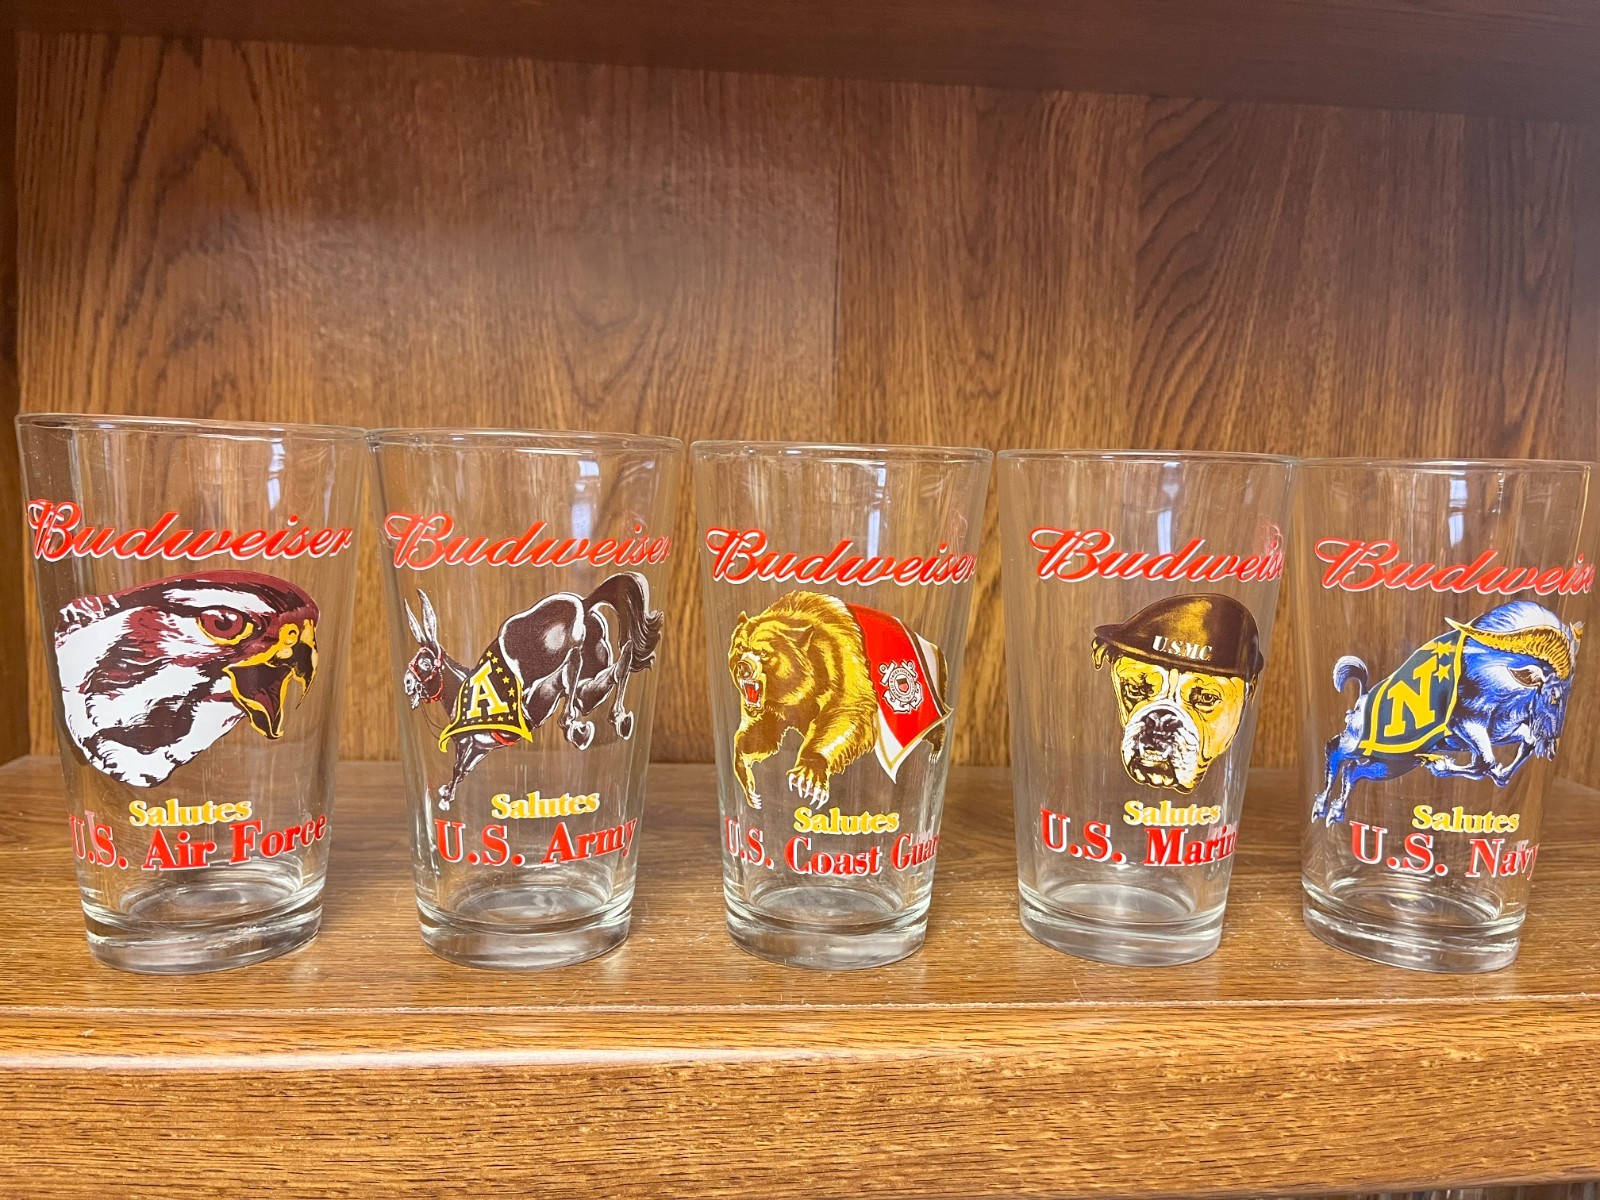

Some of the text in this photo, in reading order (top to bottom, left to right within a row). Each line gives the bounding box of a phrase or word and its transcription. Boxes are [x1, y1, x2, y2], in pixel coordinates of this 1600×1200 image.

[27, 499, 352, 562] Budweiser
[706, 526, 977, 587] Budweiser
[1029, 525, 1284, 583] Budweis
[467, 660, 508, 720] A
[1384, 656, 1438, 737] N
[129, 798, 252, 827] Salutes
[491, 790, 600, 820] Salutes
[793, 806, 899, 835] Salutes
[1122, 800, 1221, 826] Salutes
[1411, 804, 1520, 833] Salutes
[69, 813, 327, 871] U.S. Air Force
[434, 818, 638, 867] U.S. Army
[725, 816, 939, 878] U.S. Coast Guar
[1040, 809, 1237, 867] U.S. Marin
[1349, 820, 1539, 881] U.S. Navy
